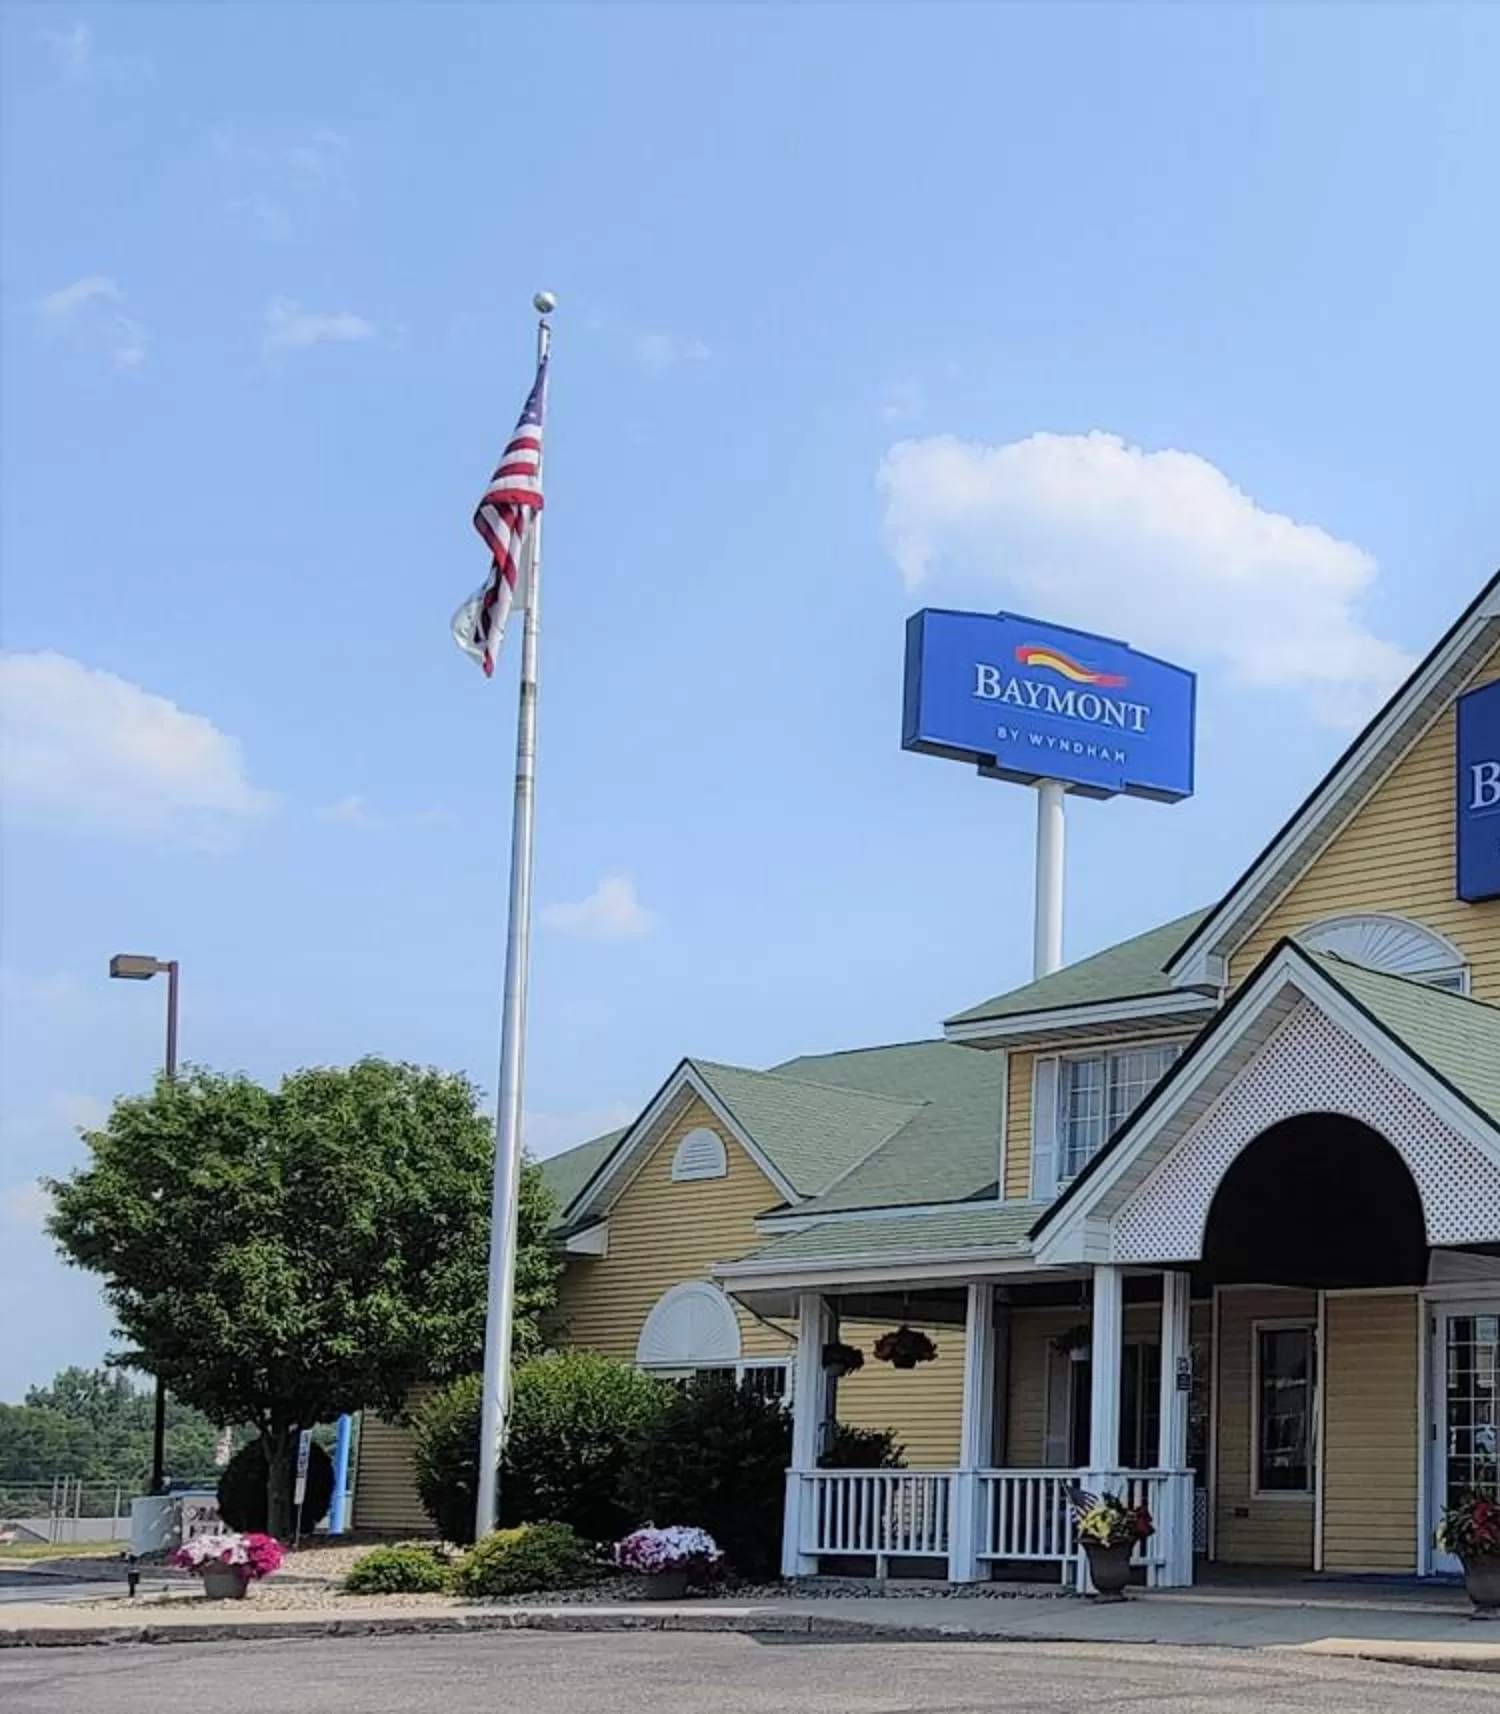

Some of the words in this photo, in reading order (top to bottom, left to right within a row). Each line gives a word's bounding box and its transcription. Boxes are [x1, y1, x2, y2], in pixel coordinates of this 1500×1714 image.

[973, 663, 1149, 733] BAYMONT
[996, 726, 1019, 741] BY
[1028, 733, 1126, 764] WYNDHAM
